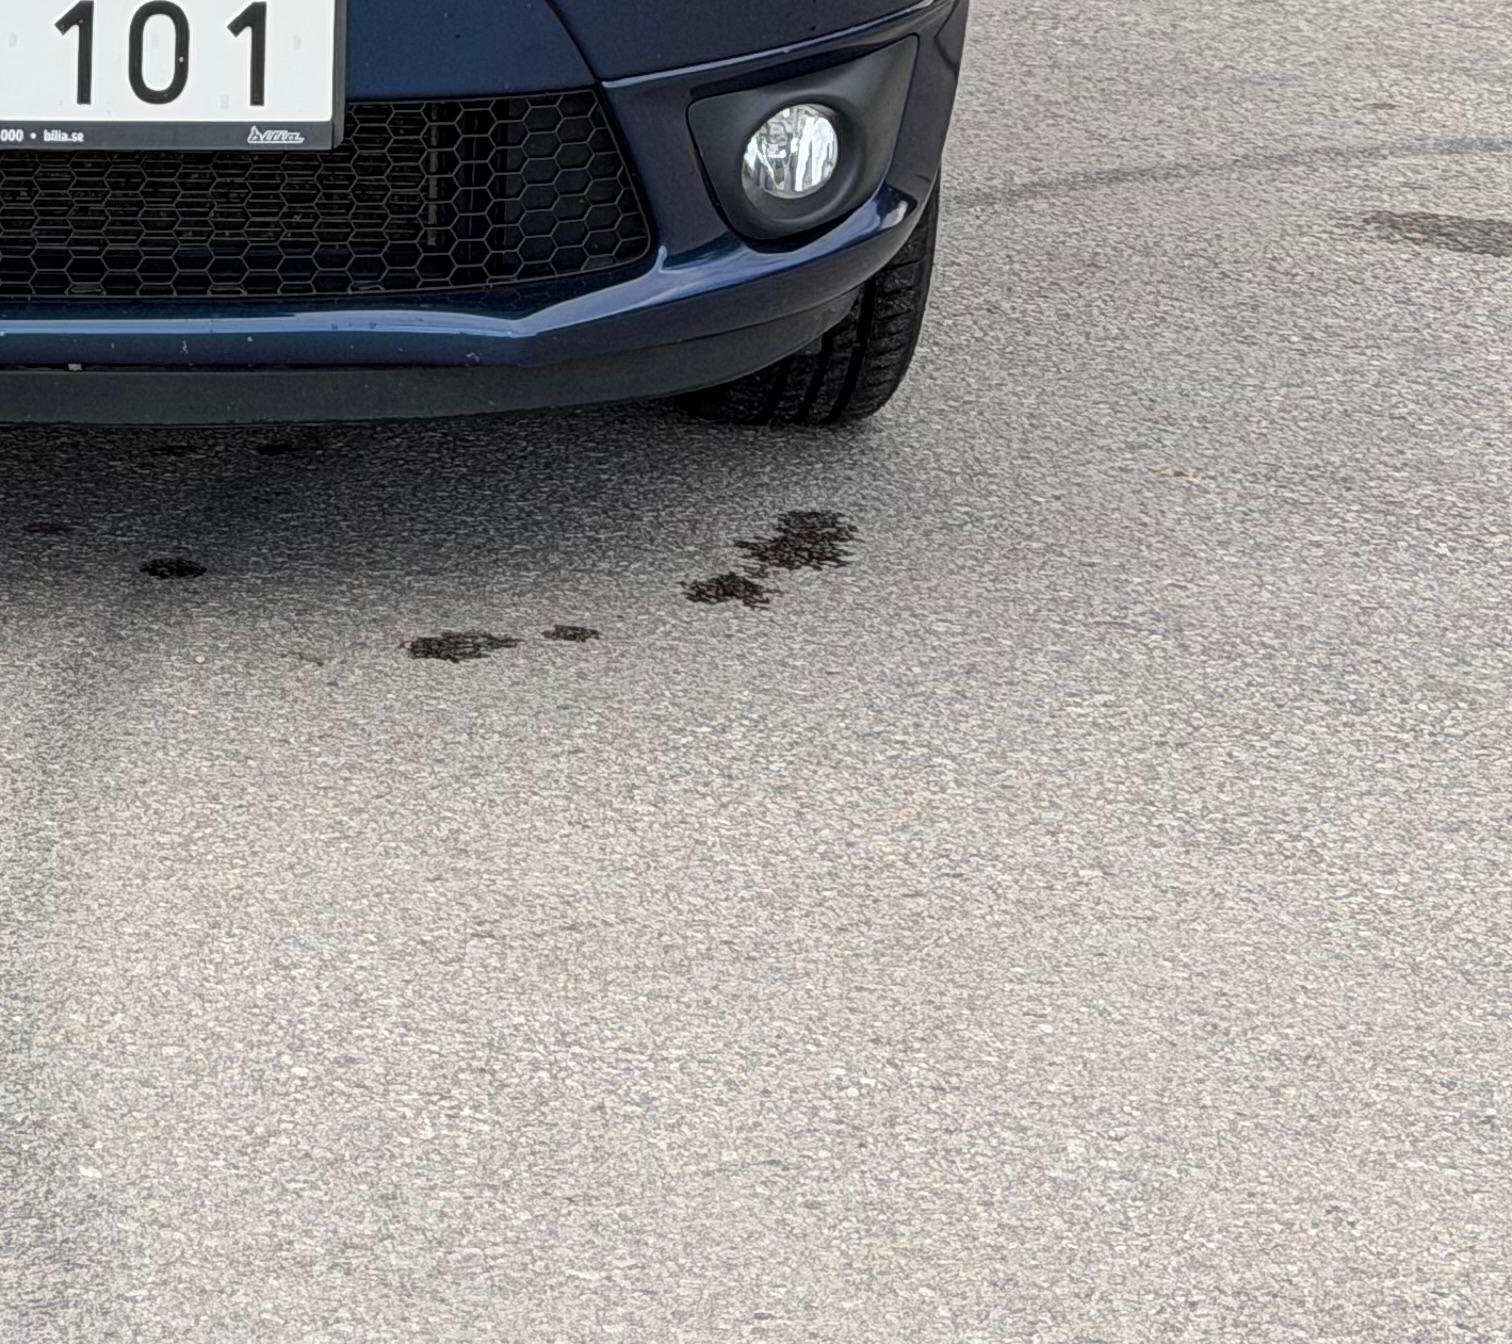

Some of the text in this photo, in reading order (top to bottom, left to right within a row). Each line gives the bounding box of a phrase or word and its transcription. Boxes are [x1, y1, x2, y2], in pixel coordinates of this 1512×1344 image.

[53, 0, 269, 107] 101
[0, 128, 24, 142] 000
[43, 128, 85, 143] bilia.se
